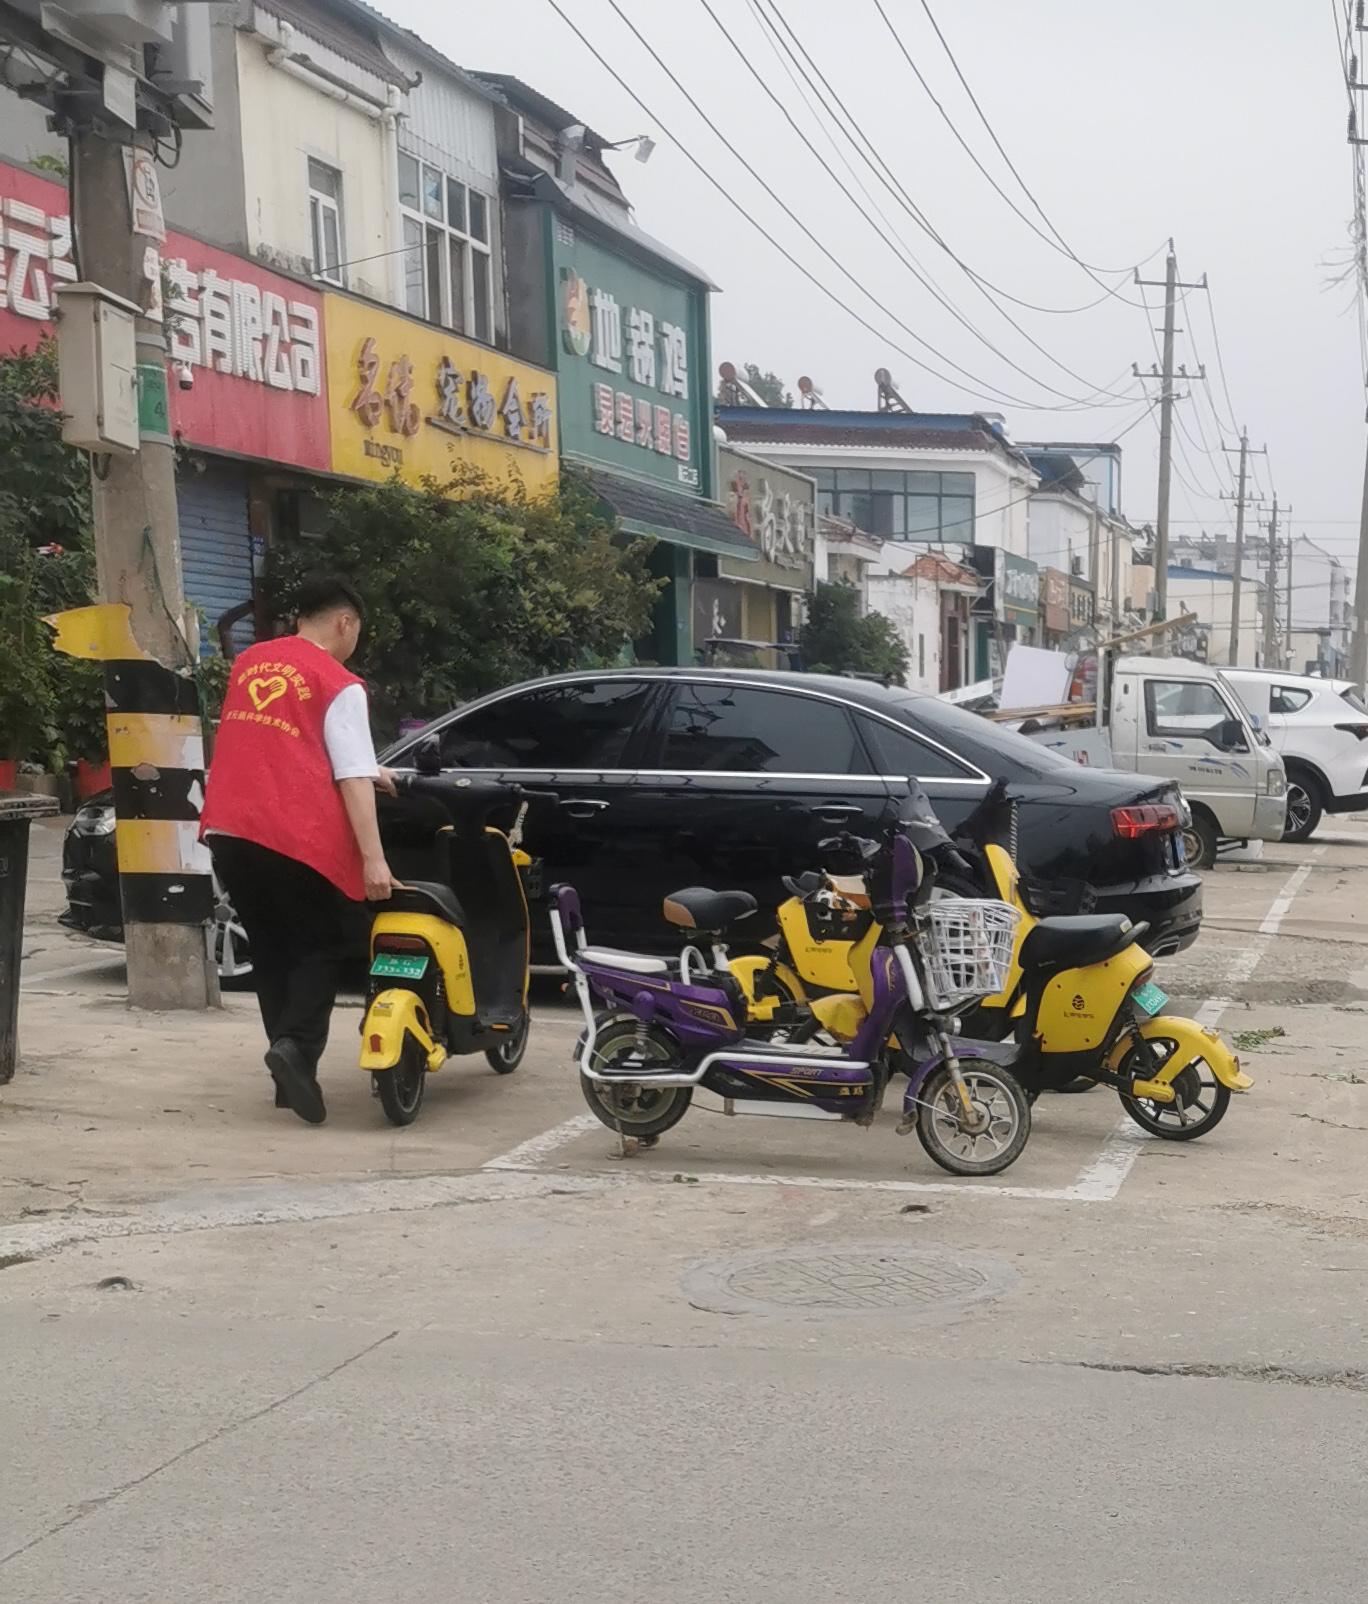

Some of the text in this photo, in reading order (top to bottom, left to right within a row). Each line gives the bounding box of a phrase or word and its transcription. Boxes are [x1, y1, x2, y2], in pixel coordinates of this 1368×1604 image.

[588, 287, 688, 399] 地锅鸡
[789, 1067, 824, 1077] SPORT
